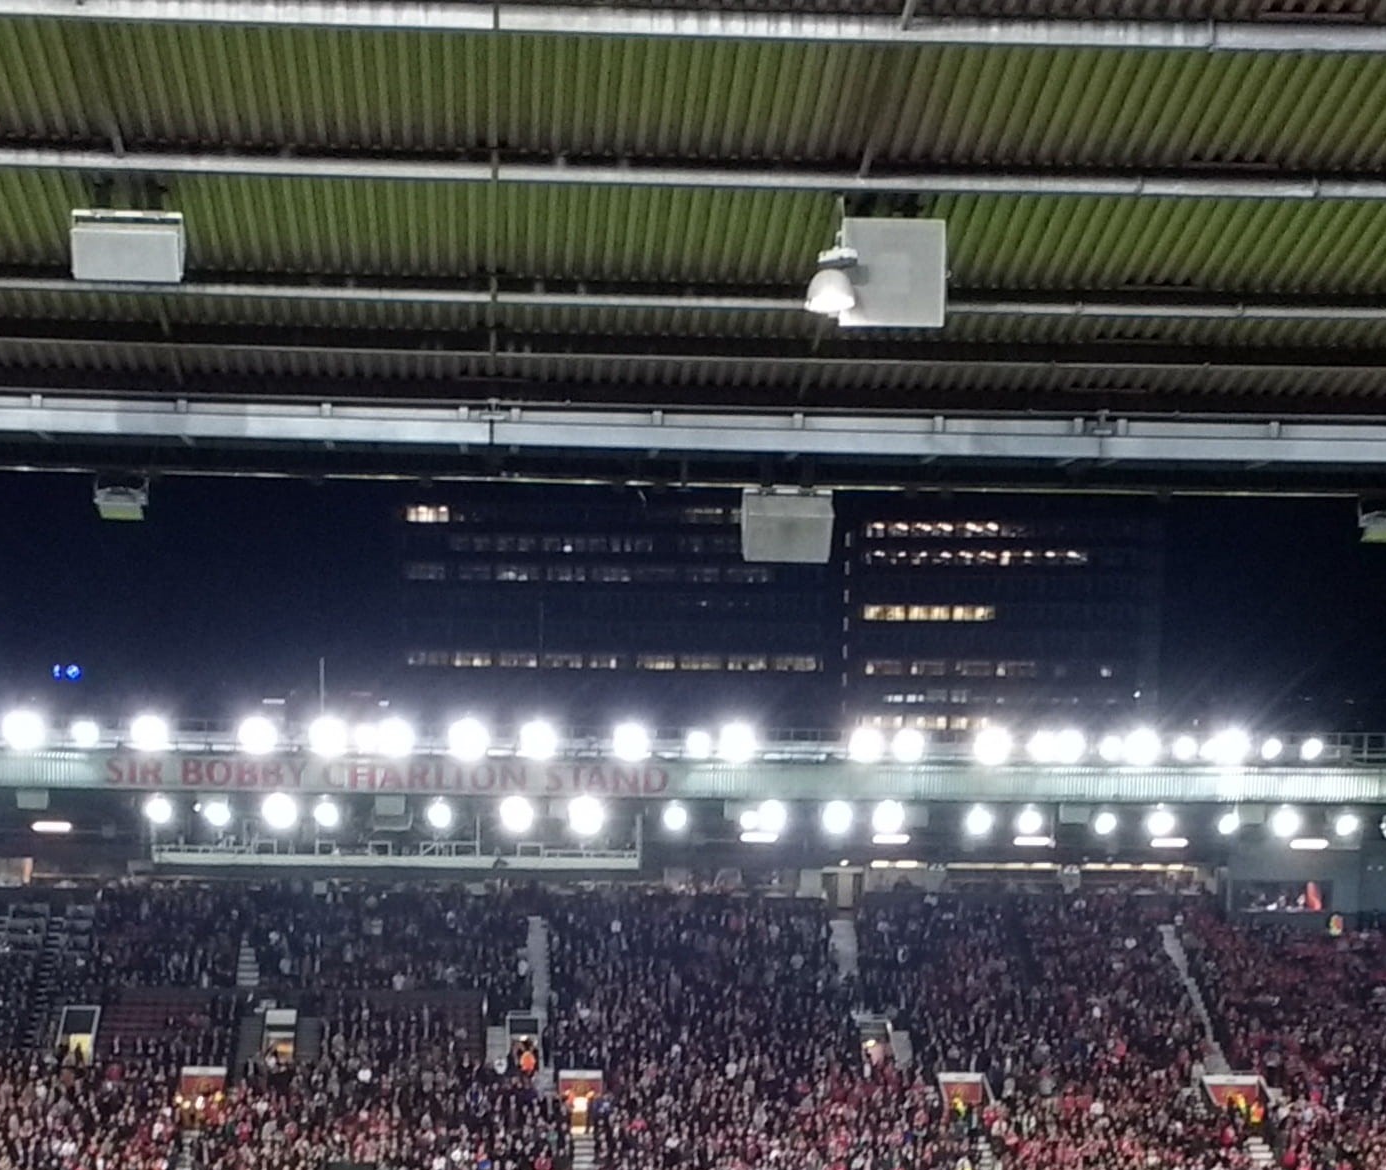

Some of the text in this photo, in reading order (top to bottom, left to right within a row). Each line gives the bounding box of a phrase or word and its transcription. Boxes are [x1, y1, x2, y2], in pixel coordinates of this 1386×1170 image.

[106, 758, 162, 787] SIR
[181, 757, 308, 789] BOBBY
[545, 762, 669, 794] STAND
